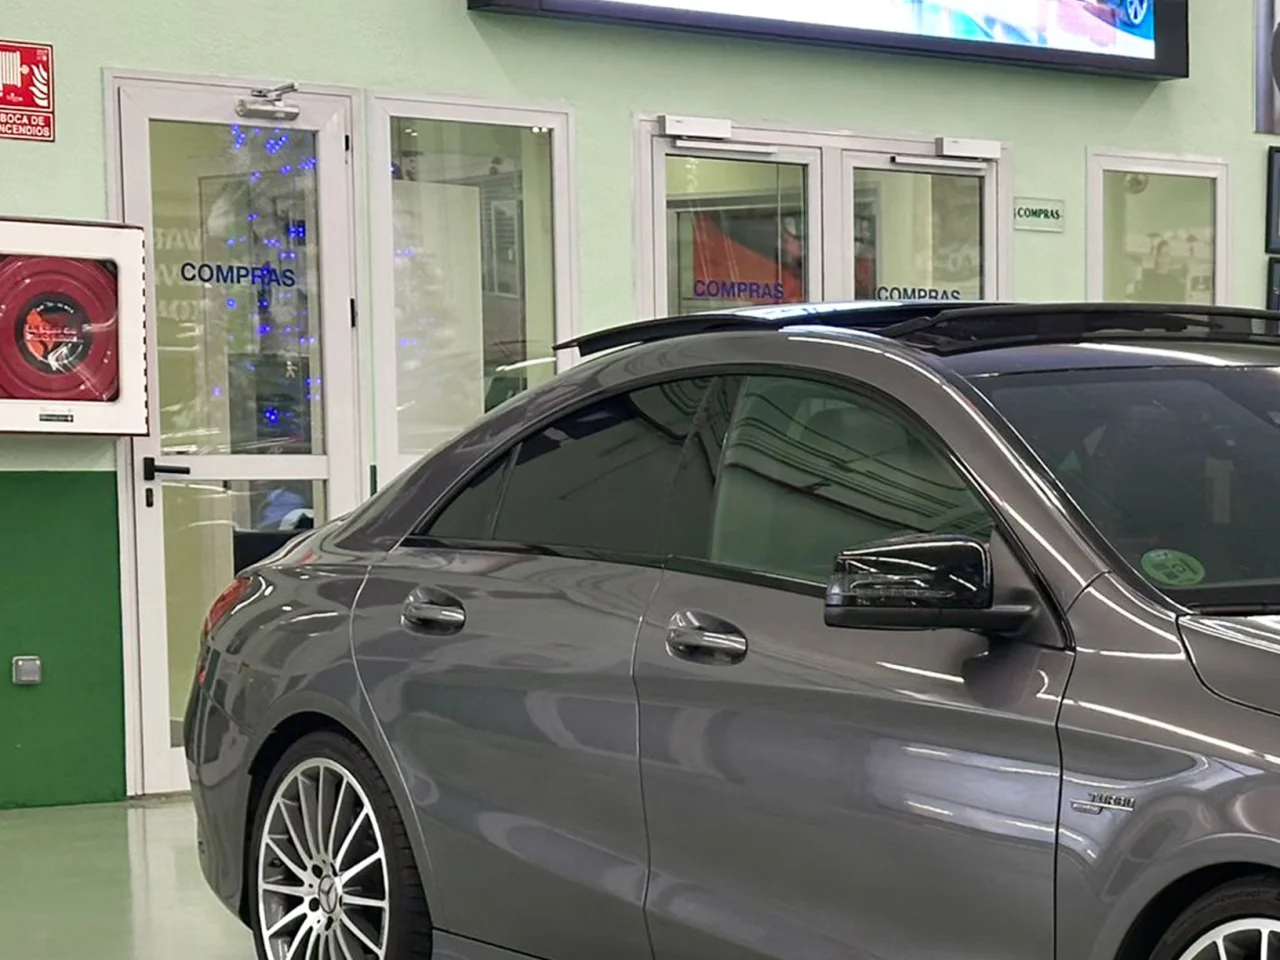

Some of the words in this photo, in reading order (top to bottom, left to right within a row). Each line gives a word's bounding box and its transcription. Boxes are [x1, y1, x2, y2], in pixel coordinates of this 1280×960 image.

[0, 113, 29, 125] BOCA
[31, 115, 45, 126] DE
[0, 123, 50, 137] NCENDIOS
[1016, 207, 1061, 221] COMPRAS
[180, 262, 296, 288] COMPRAS
[693, 279, 784, 299] COMPRAS
